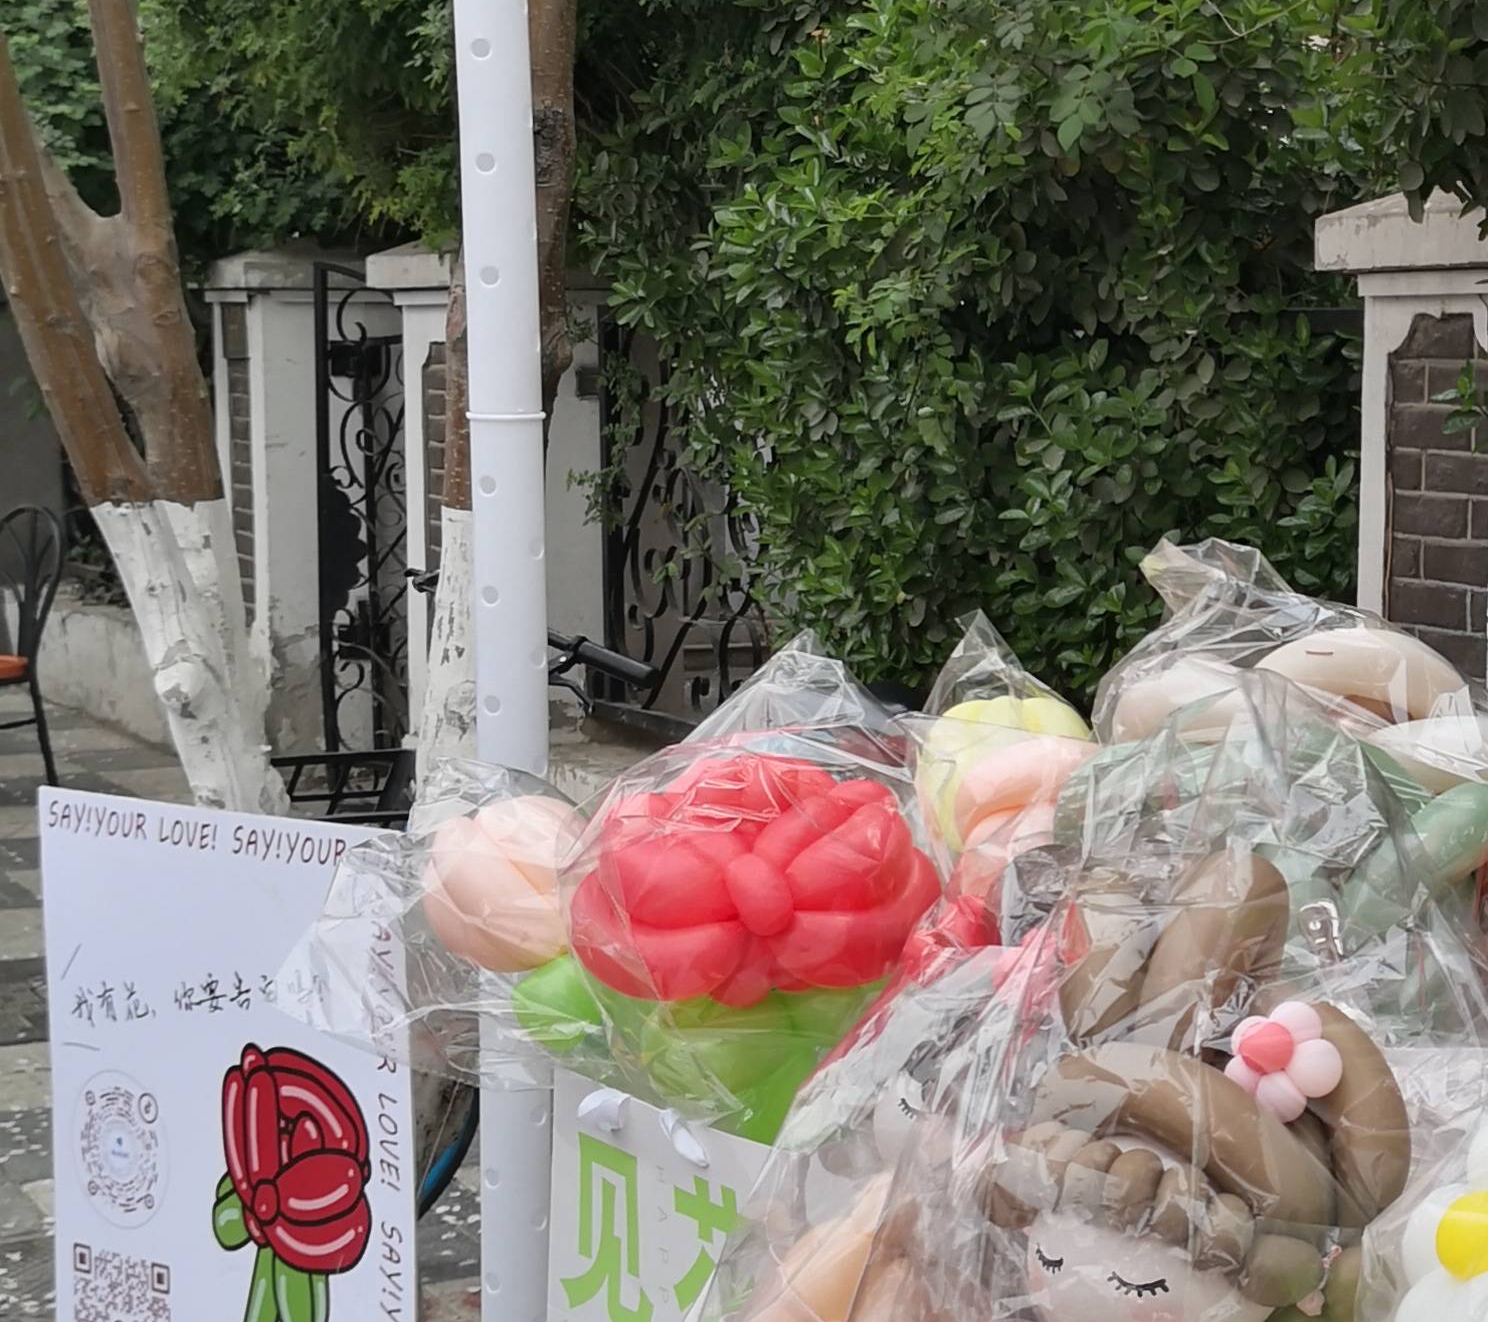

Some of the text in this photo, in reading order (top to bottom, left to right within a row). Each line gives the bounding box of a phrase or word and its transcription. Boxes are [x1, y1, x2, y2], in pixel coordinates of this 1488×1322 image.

[48, 799, 147, 840] SAY!YOUR
[158, 815, 217, 852] LOVE!
[377, 1092, 400, 1192] LOVE!
